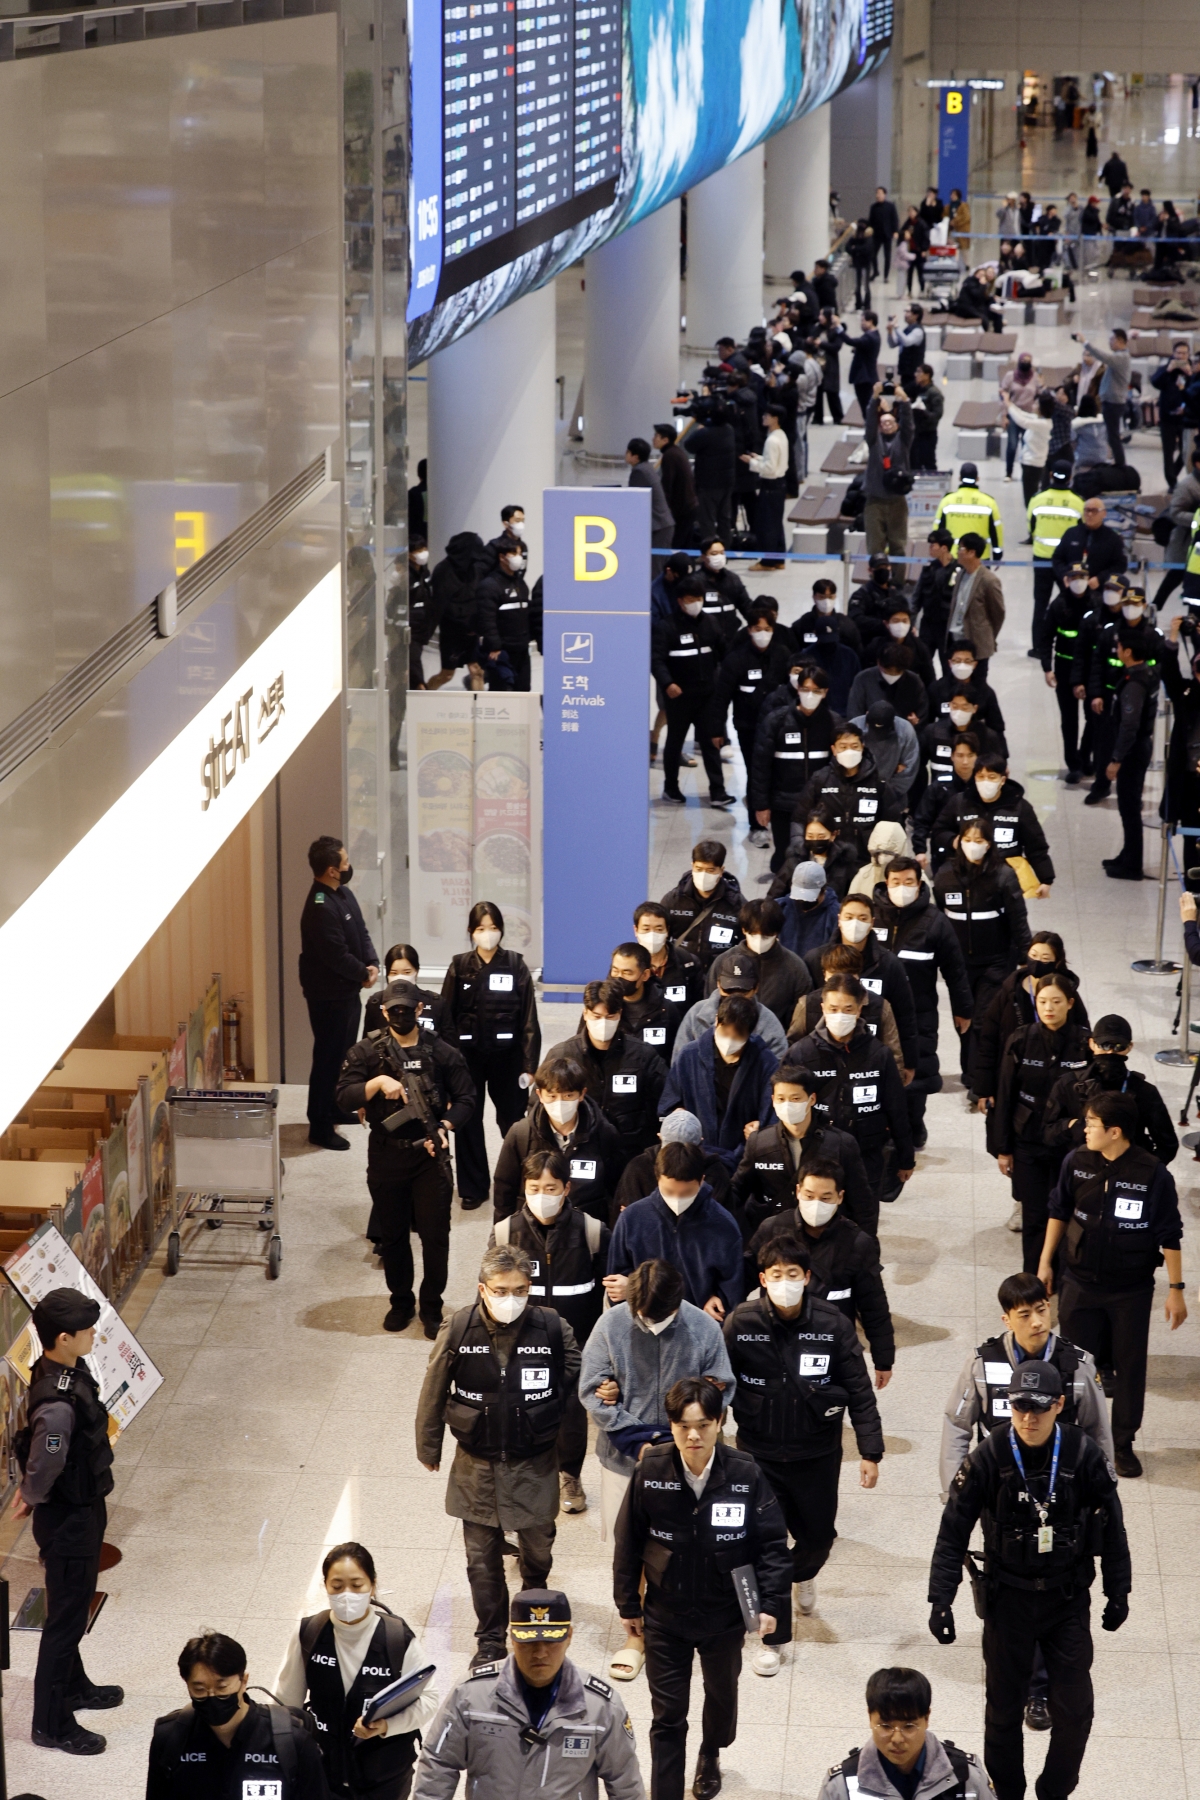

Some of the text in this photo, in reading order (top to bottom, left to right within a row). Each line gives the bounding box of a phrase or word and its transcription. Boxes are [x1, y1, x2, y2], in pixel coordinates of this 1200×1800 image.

[946, 92, 963, 114] B
[574, 515, 620, 582] B
[561, 675, 589, 691] 도착
[561, 694, 606, 706] Arrivals
[712, 912, 738, 922] POLICE
[404, 1060, 422, 1069] LICE
[1022, 1058, 1044, 1068] OLICE
[849, 1070, 880, 1080] POLICE
[754, 1162, 784, 1170] POLICE
[1115, 1181, 1148, 1192] POLICE
[1118, 1221, 1149, 1230] POLICE
[737, 1334, 770, 1342] POLICE
[798, 1332, 834, 1342] POLICE
[458, 1346, 490, 1354] OLICE
[525, 1388, 553, 1402] POLICE
[644, 1480, 682, 1490] POLICE
[731, 1484, 750, 1493] ICE
[716, 1531, 746, 1542] POLIC
[564, 1737, 587, 1750] 경찰
[180, 1752, 207, 1762] LICE
[244, 1753, 279, 1764] POLIC
